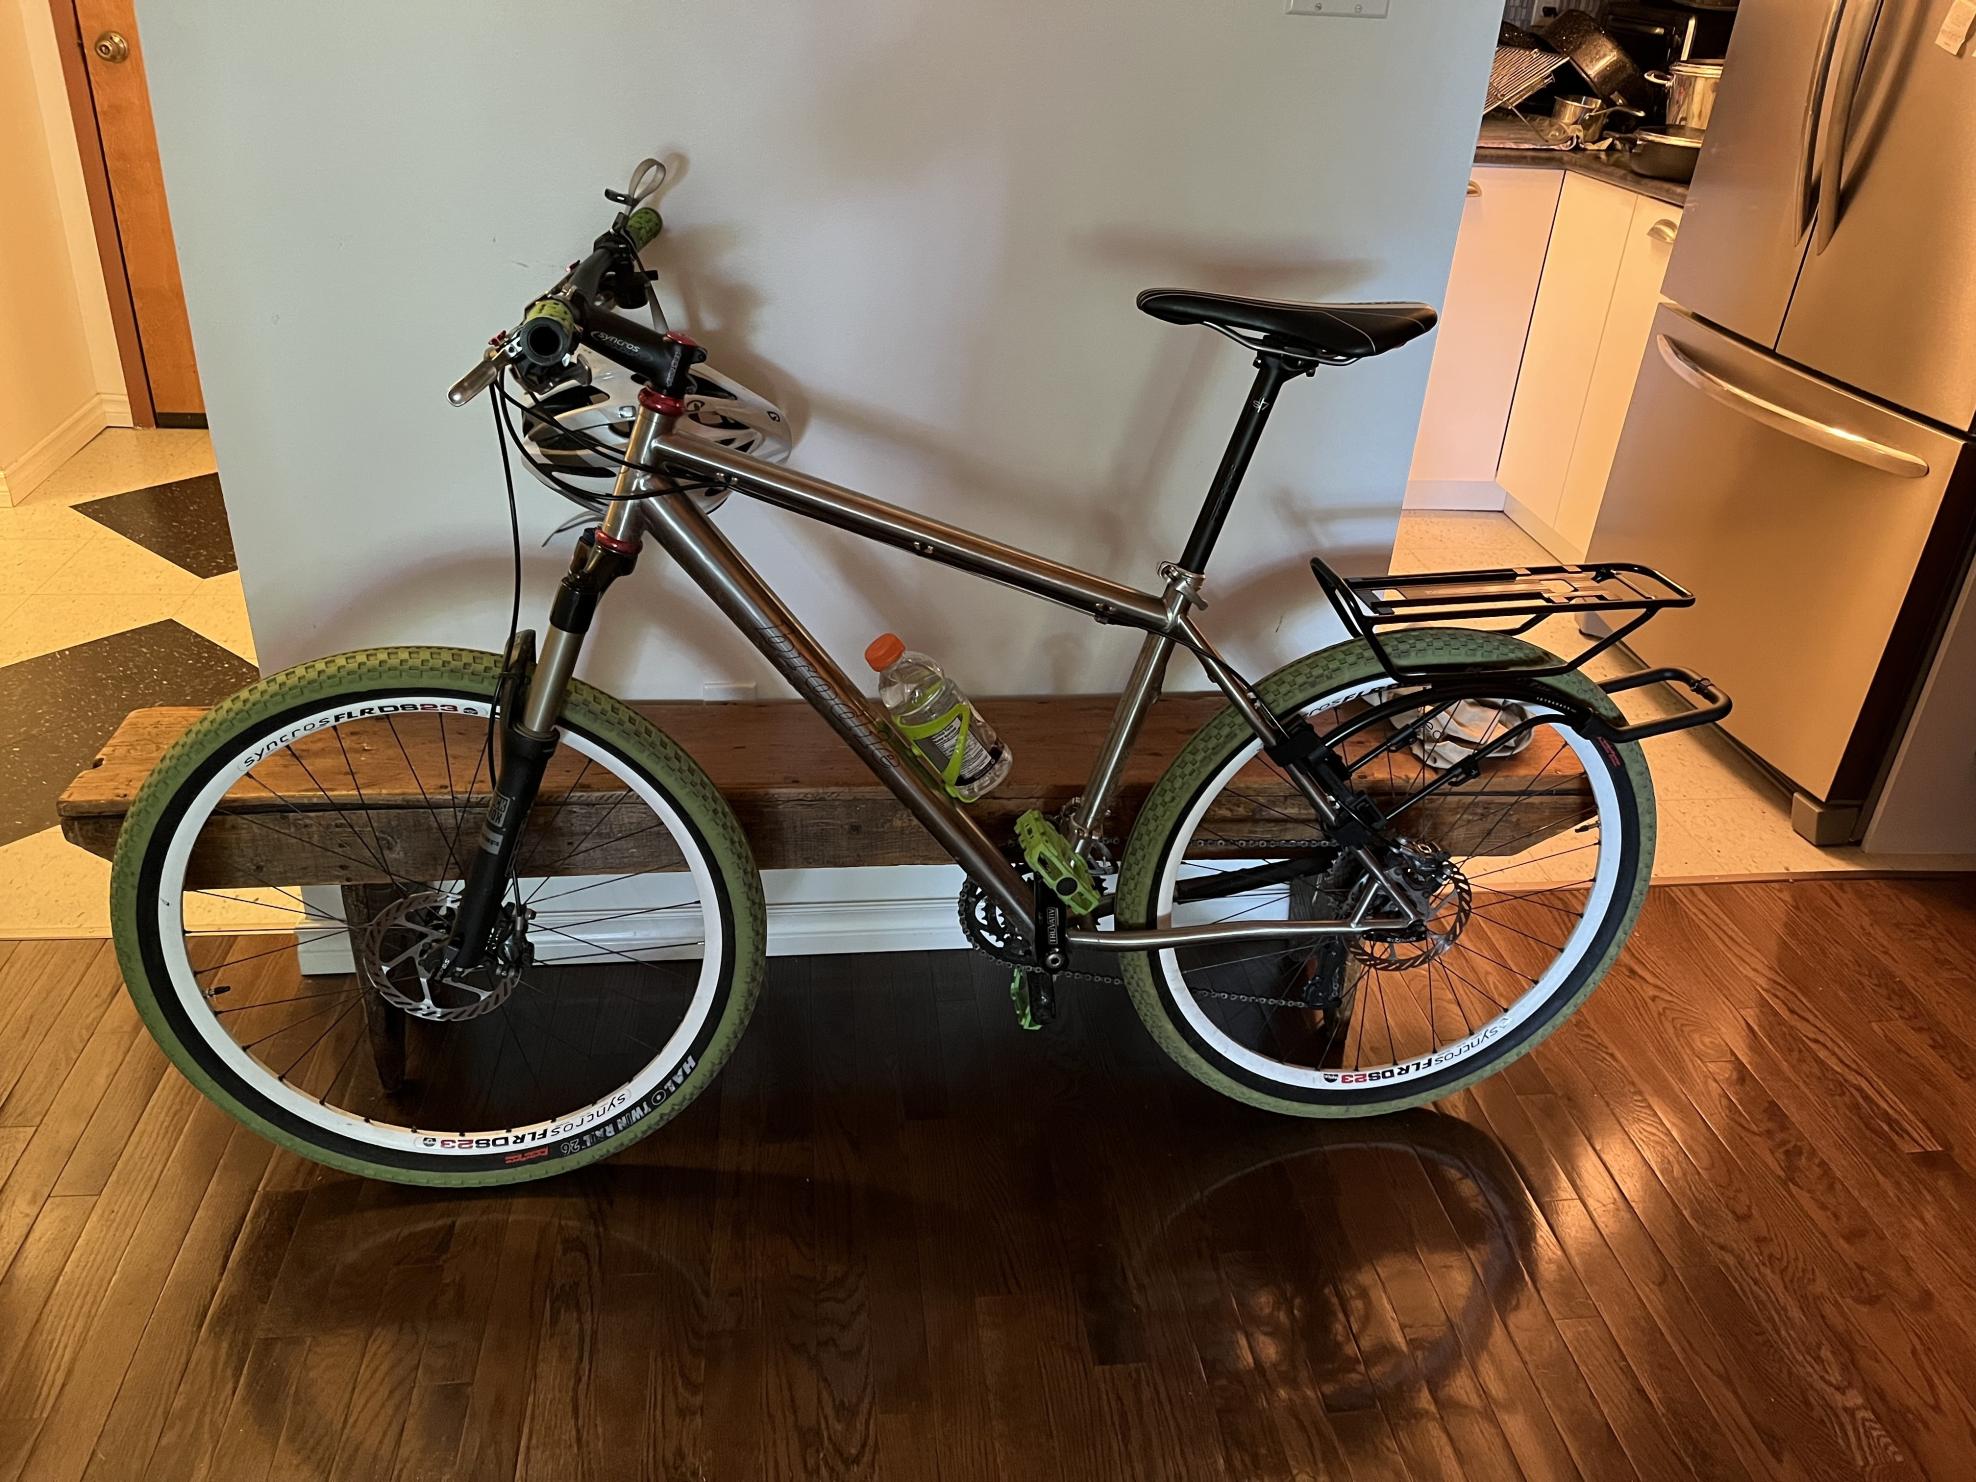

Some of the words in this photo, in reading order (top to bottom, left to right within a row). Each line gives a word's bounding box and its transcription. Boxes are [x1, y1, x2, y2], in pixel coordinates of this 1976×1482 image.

[599, 332, 640, 353] syncros
[755, 621, 900, 768] brodie
[244, 717, 331, 767] syncros
[1434, 1026, 1500, 1065] syncros
[651, 1055, 697, 1106] HALO
[550, 1093, 626, 1137] syncros
